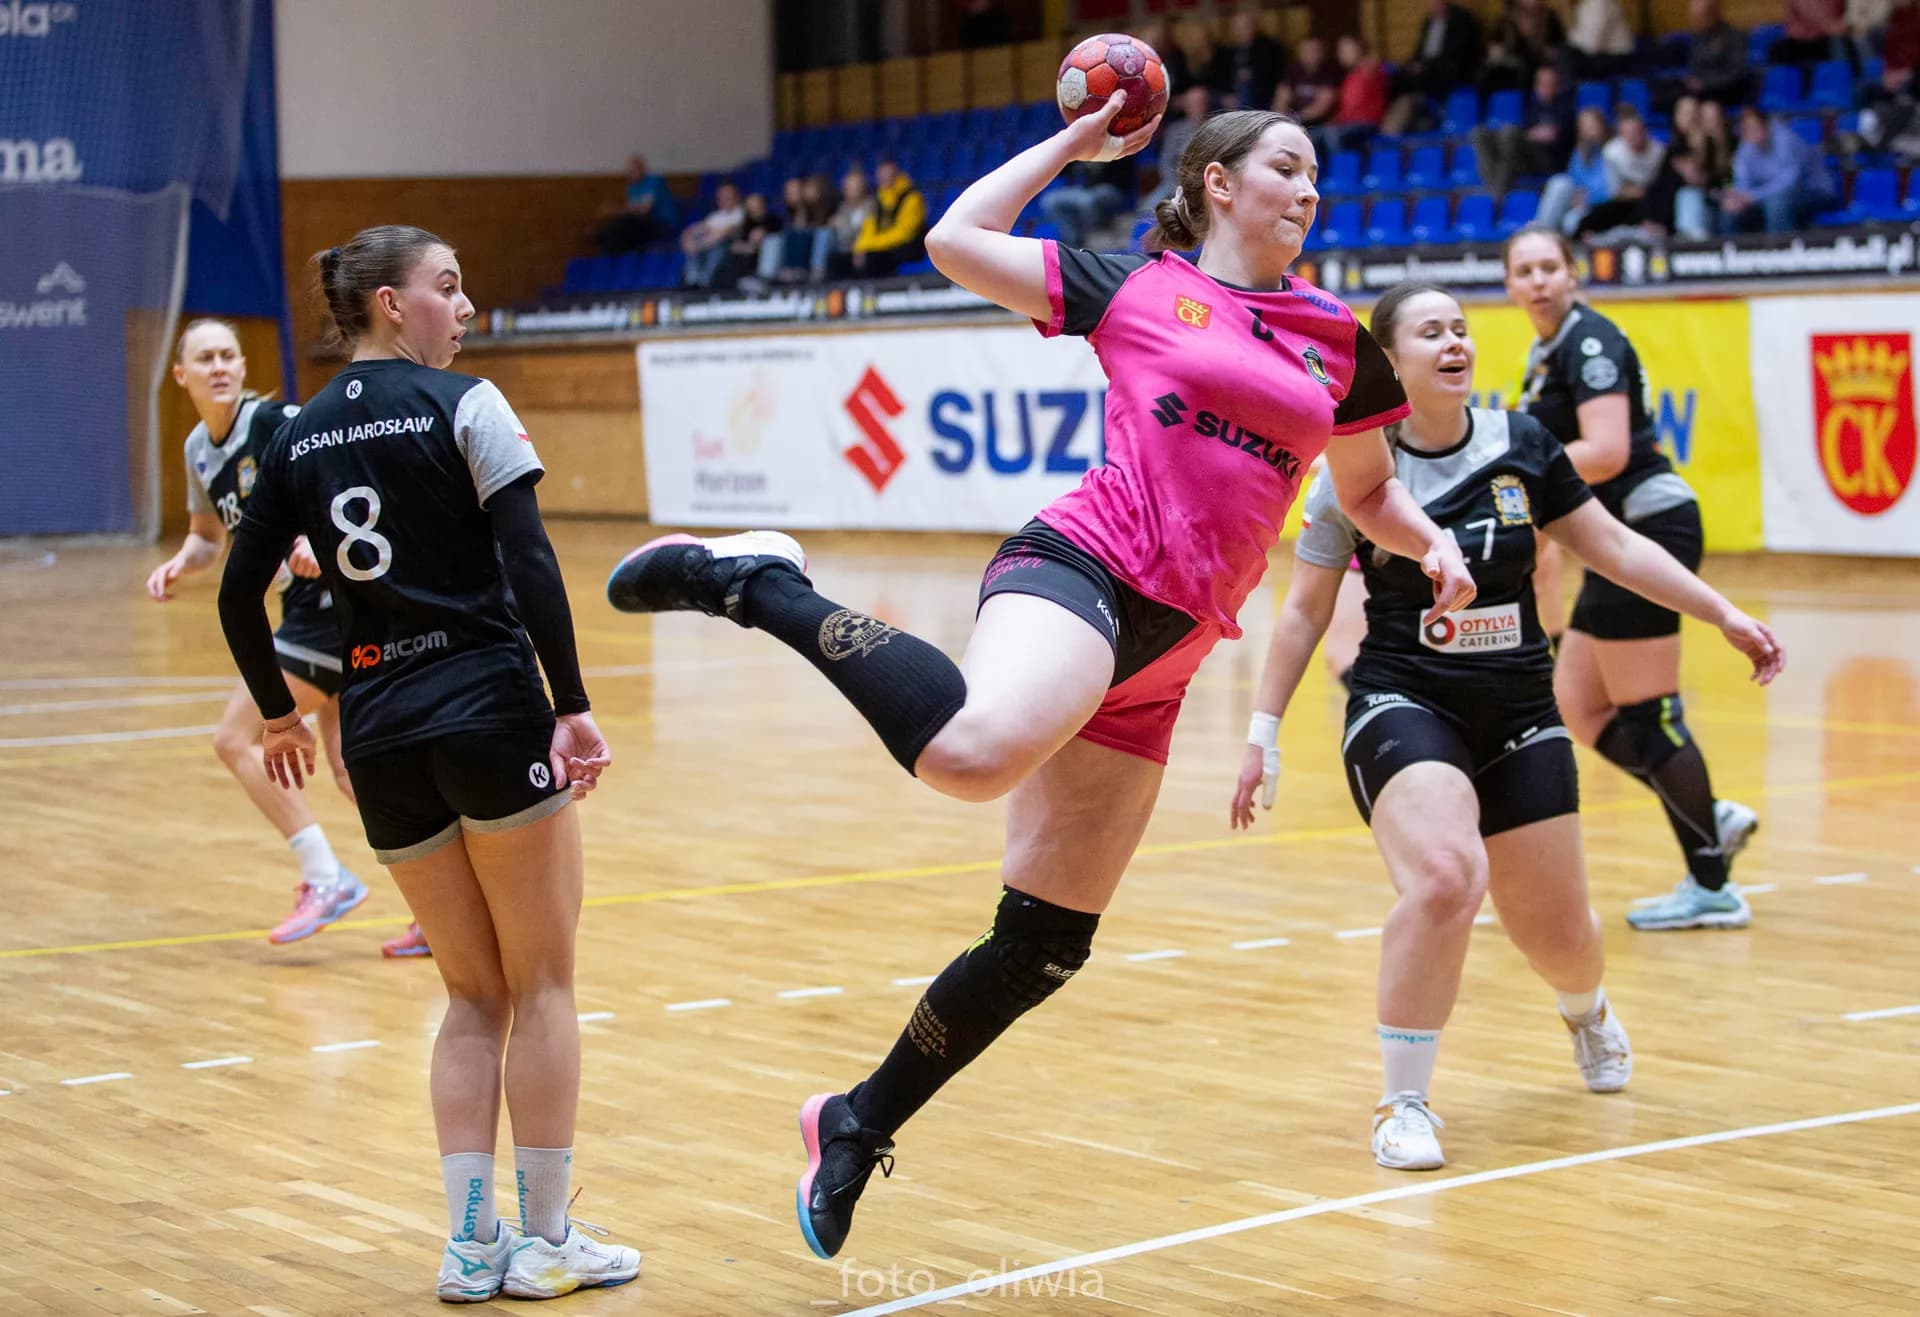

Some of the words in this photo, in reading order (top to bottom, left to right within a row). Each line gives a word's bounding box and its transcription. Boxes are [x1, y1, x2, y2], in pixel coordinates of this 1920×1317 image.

[1178, 306, 1204, 328] CK
[310, 429, 343, 450] SAN
[346, 416, 434, 444] JAROSŁAW
[928, 387, 1105, 475] SUZ
[1193, 410, 1302, 479] SUZUKI
[1822, 402, 1901, 497] CK
[331, 486, 393, 582] 8
[1460, 614, 1516, 633] OTYLYA
[1460, 633, 1518, 648] CATERING
